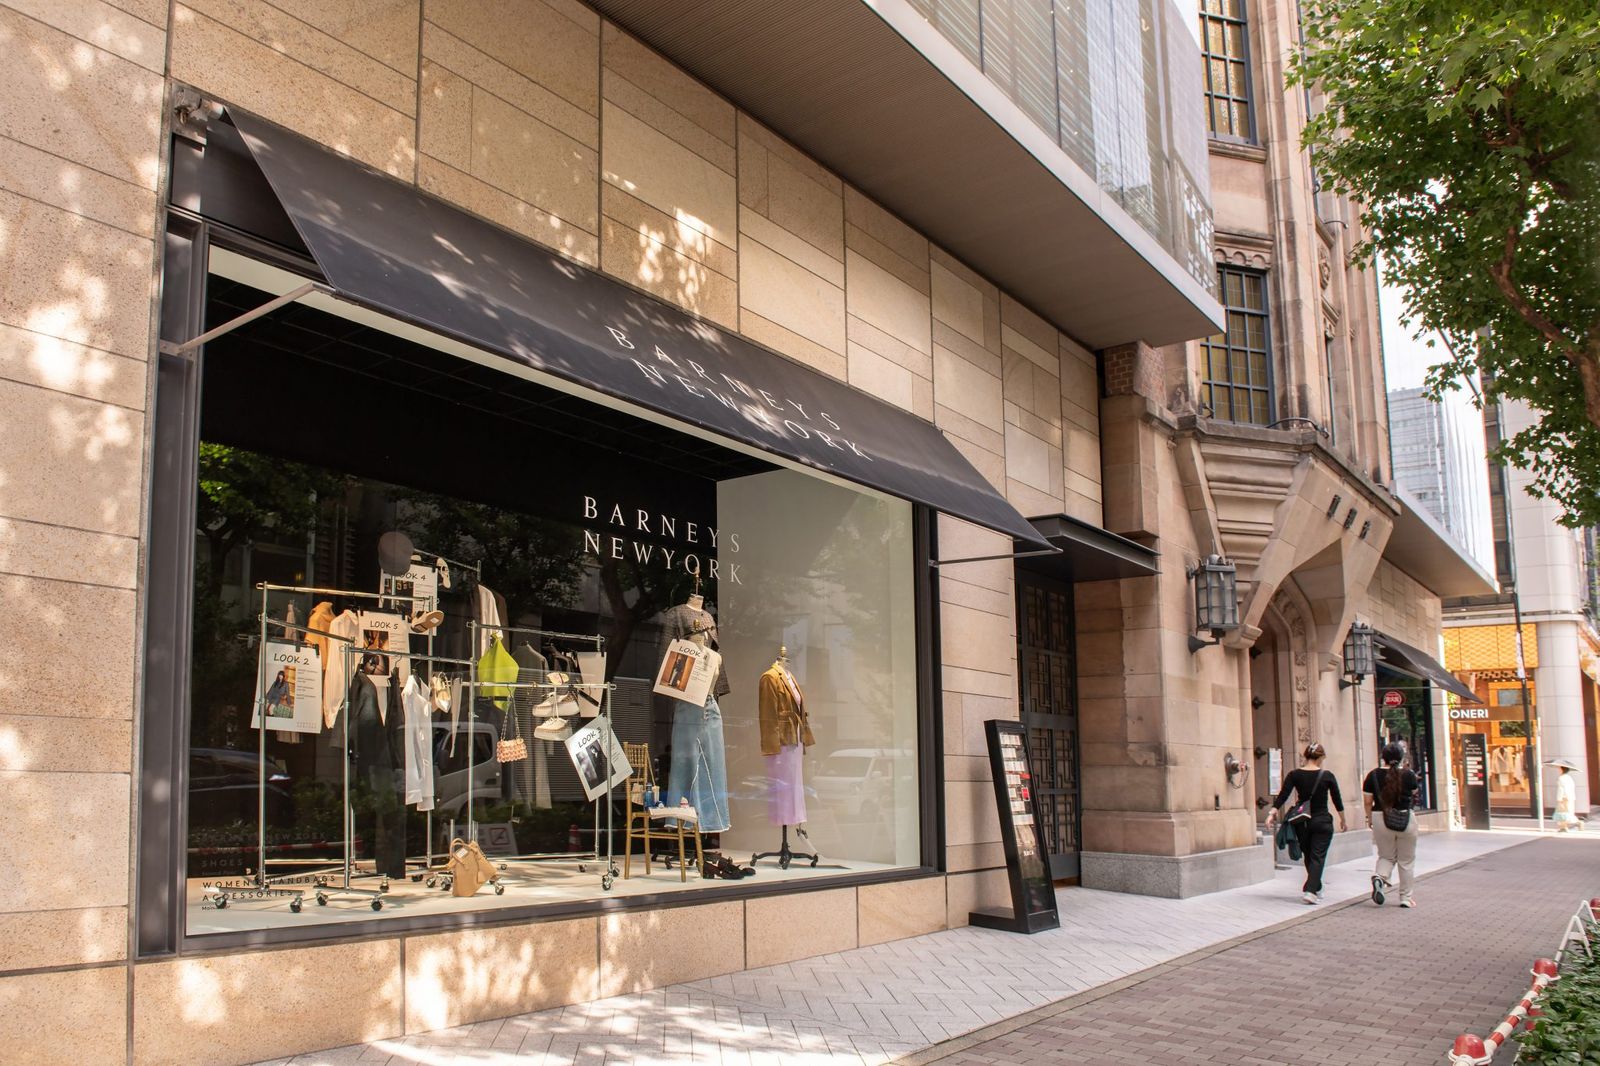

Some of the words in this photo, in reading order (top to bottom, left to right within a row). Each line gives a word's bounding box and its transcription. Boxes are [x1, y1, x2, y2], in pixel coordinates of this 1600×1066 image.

[604, 326, 840, 430] BARNEYS
[584, 495, 739, 553] BARNEYS
[370, 621, 391, 629] LOOK
[679, 646, 701, 657] LOOK
[273, 653, 300, 664] LOOK
[577, 731, 596, 748] LOOK
[269, 875, 335, 885] HANDBAGS
